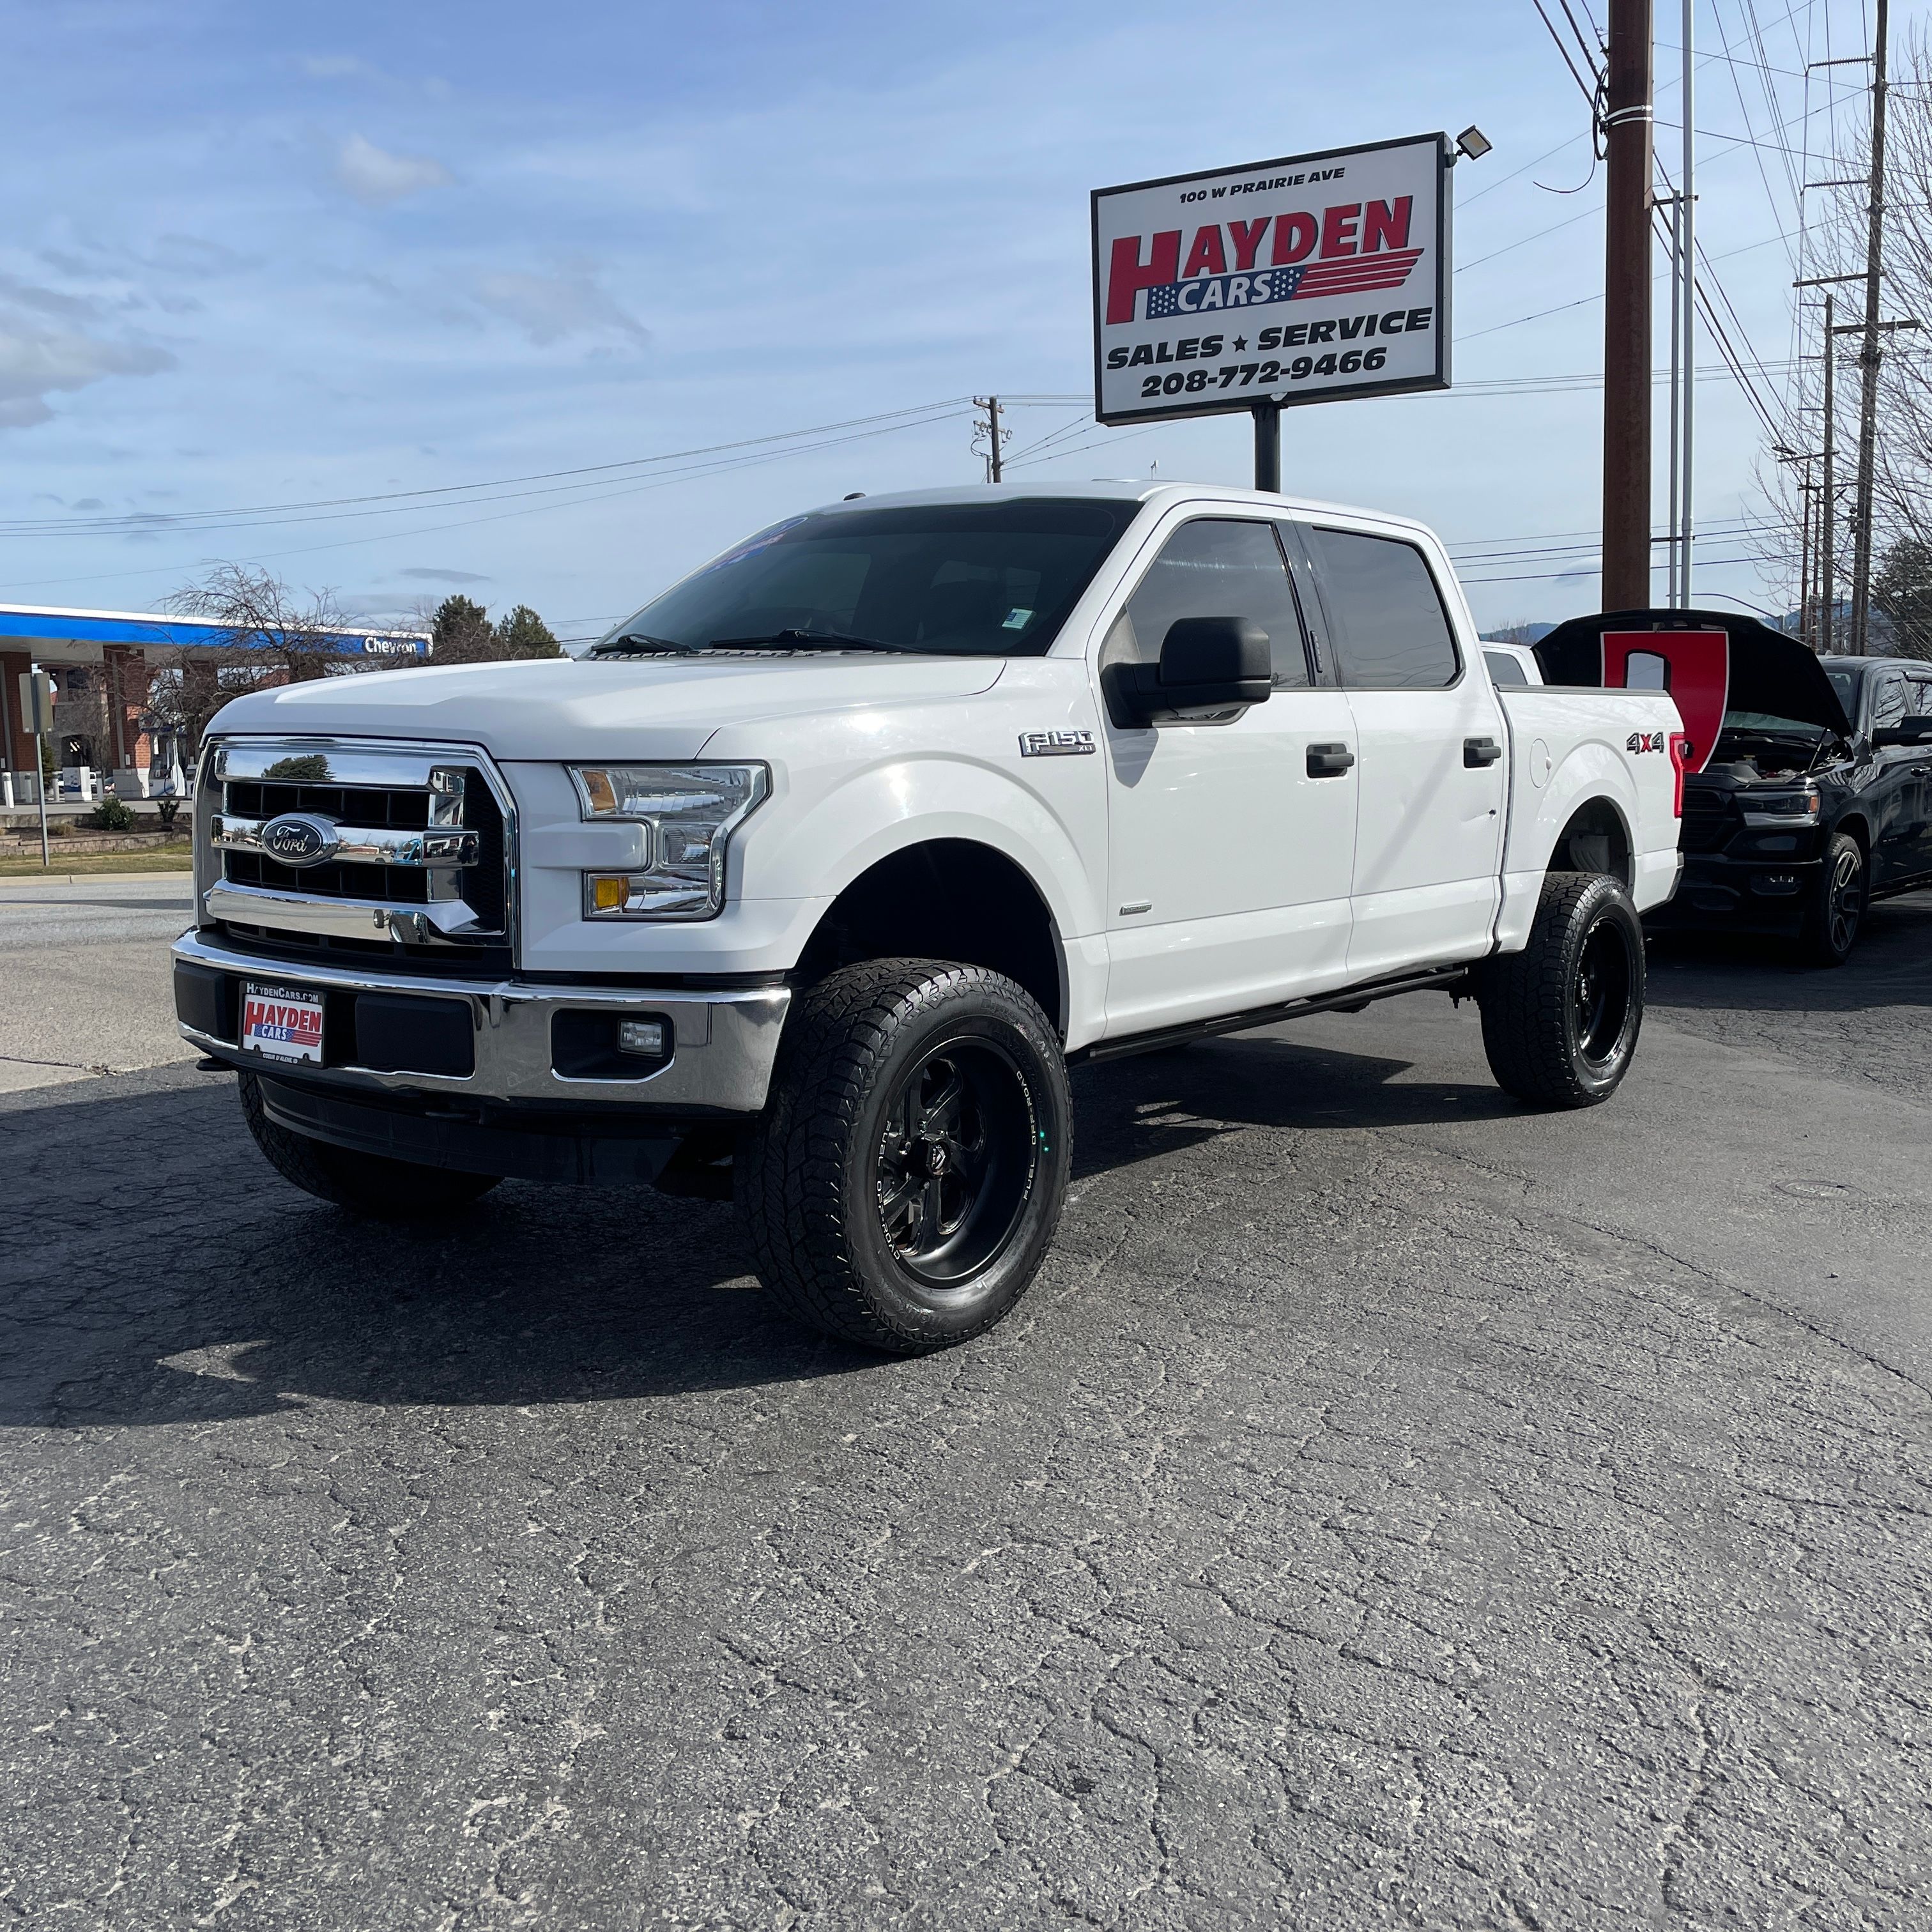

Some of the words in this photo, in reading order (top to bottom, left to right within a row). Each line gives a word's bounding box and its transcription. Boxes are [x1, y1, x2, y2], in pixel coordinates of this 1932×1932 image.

[1180, 190, 1208, 204] 100
[1211, 186, 1228, 199] W
[1229, 174, 1306, 195] PRAIRIE
[1307, 167, 1346, 183] AVE
[1106, 195, 1413, 325] HAYDEN
[1177, 271, 1274, 313] CARS
[1107, 334, 1224, 369] SALES
[1257, 307, 1433, 350] SERVICE
[1140, 346, 1387, 397] 208-772-9466
[365, 636, 417, 654] Chevron
[273, 825, 309, 852] Ford
[244, 1000, 322, 1036] HAYDEN
[261, 1025, 288, 1040] CARS
